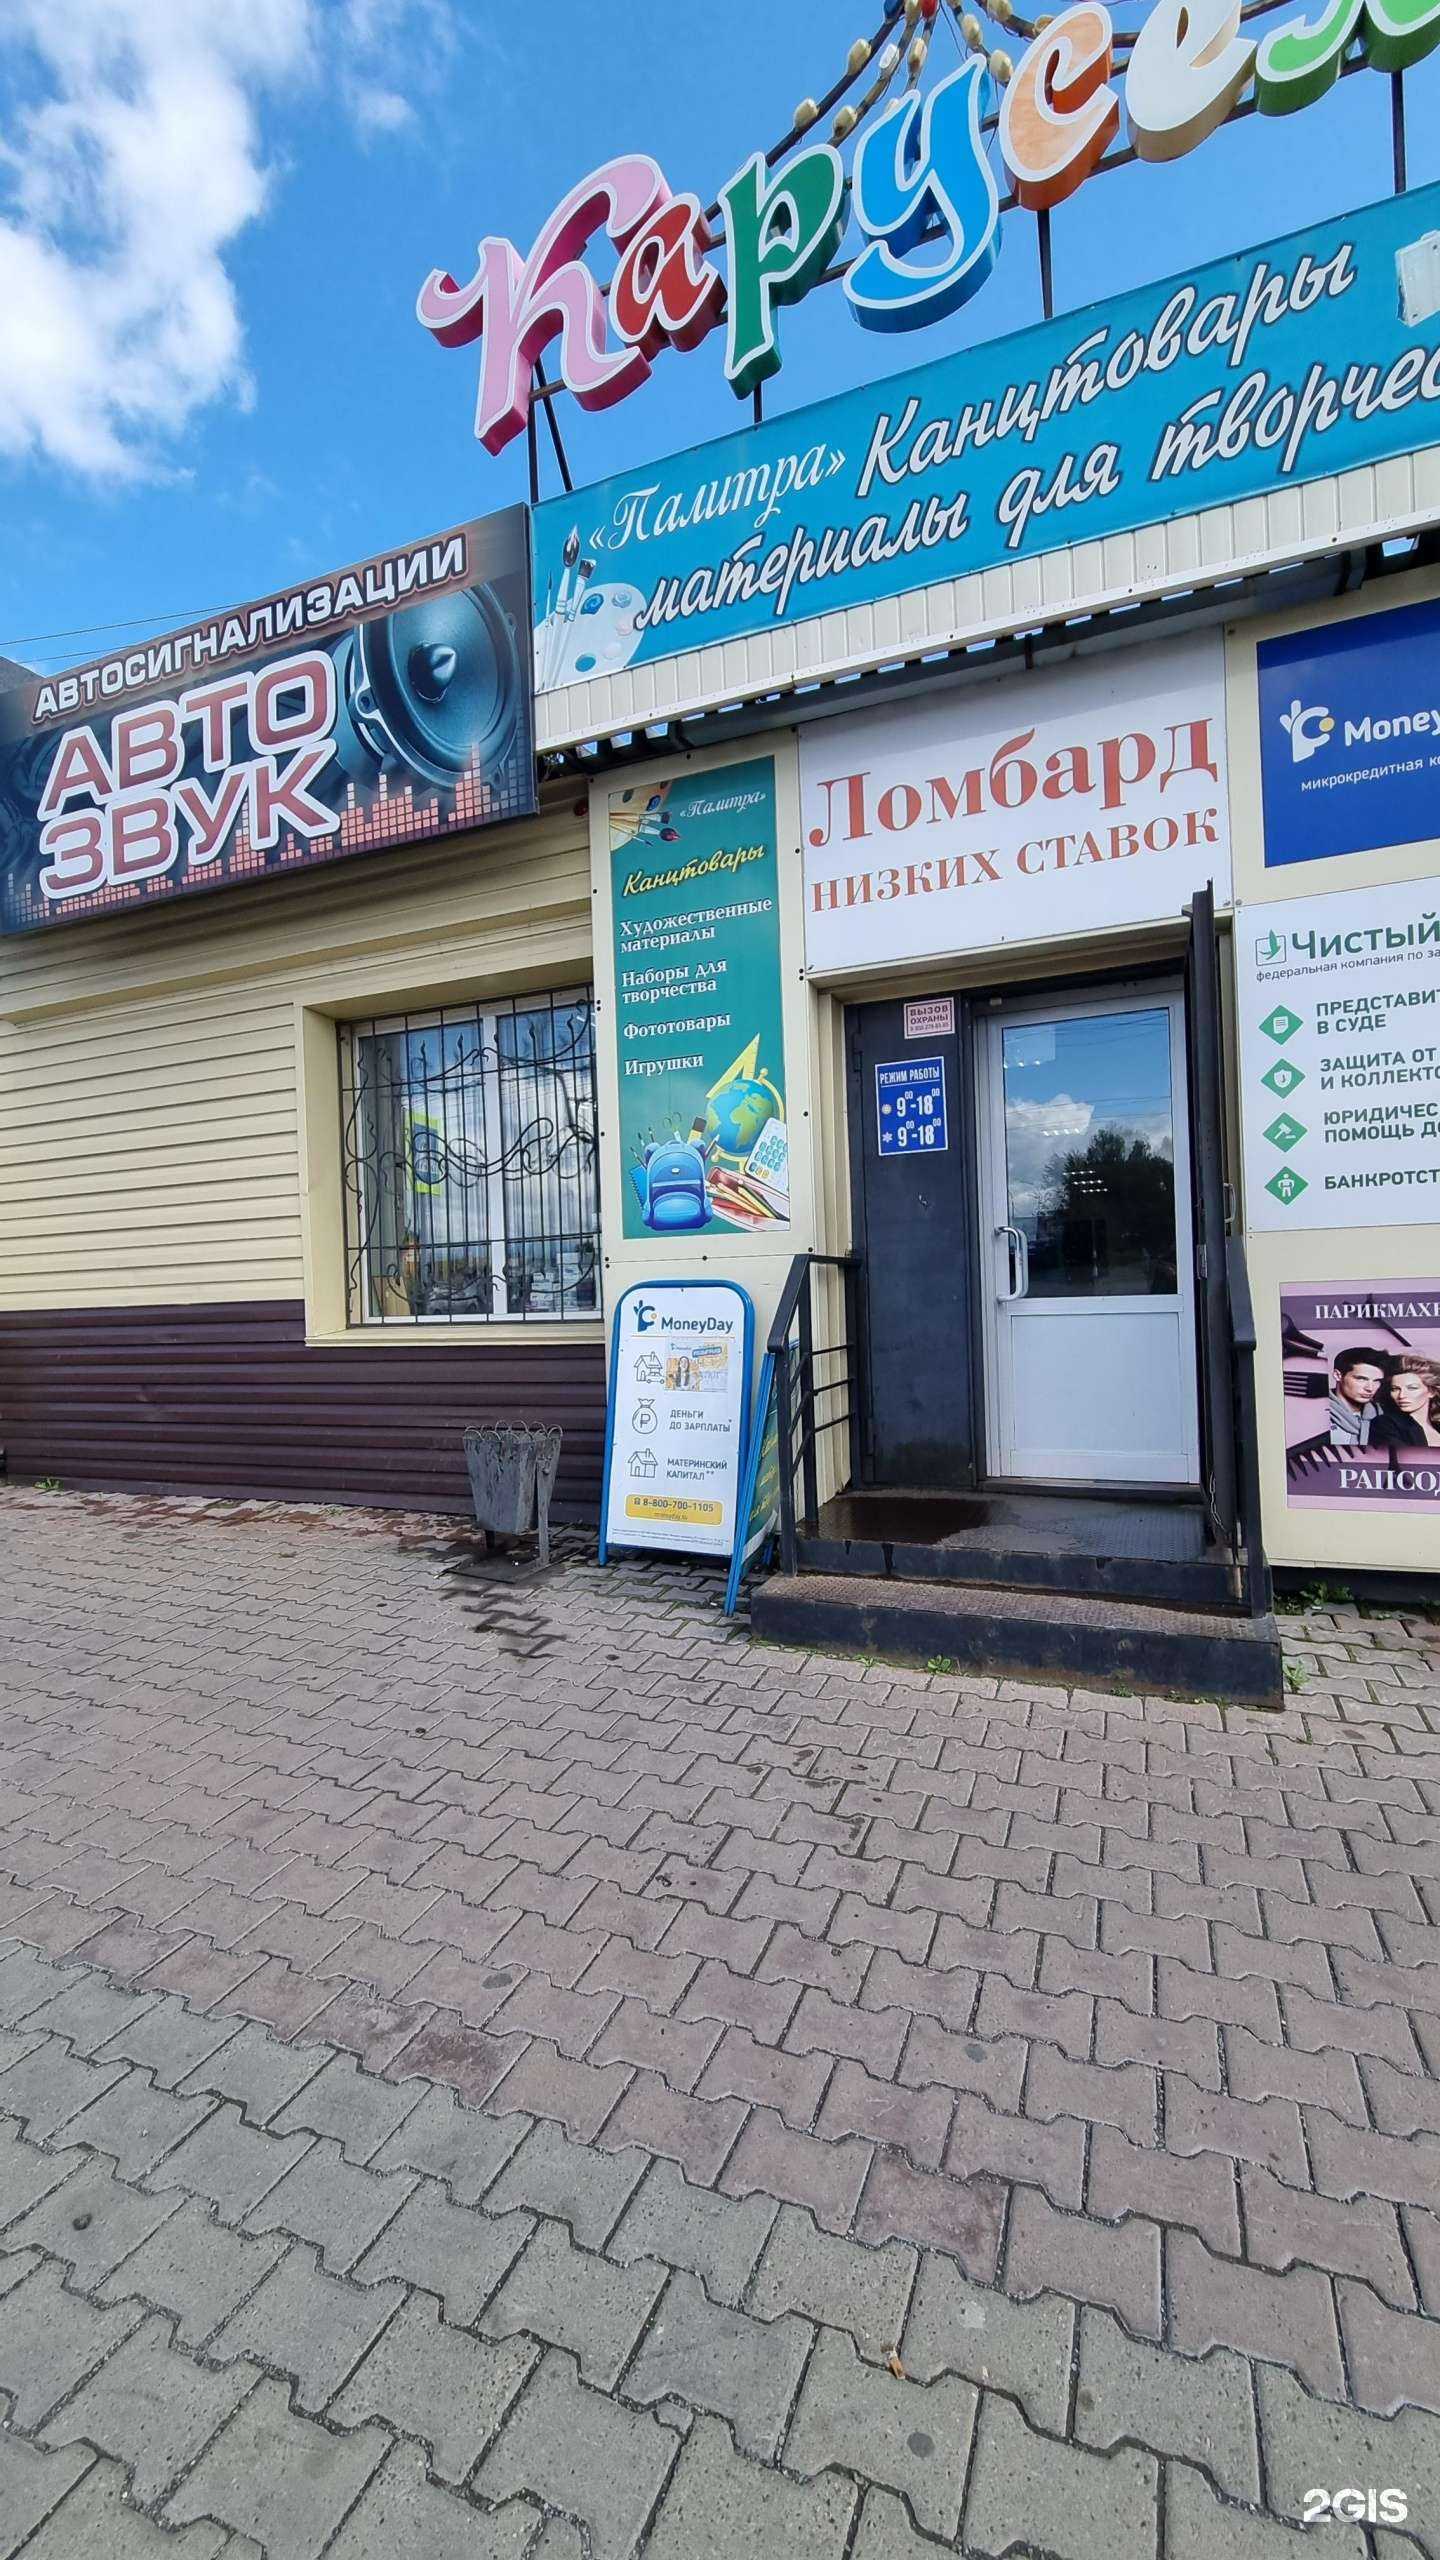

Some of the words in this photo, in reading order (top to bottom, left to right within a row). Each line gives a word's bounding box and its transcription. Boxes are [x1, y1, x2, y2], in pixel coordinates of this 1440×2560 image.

[857, 244, 1356, 497] Канцтовары
[633, 494, 969, 630] материалы
[998, 443, 1121, 549] для
[34, 535, 465, 719] АВТОСИГНАЛИЗАЦИИ
[38, 650, 337, 821] АВТО
[808, 717, 1219, 847] Ломбард
[1301, 757, 1424, 793] микрокредитная
[39, 738, 340, 900] ЗВУК
[622, 842, 765, 897] Канцтовары
[811, 848, 1003, 912] НИЗКИХ
[1016, 807, 1220, 875] СТАВОК
[619, 897, 772, 937] Художественные
[621, 927, 715, 953] материалы
[1291, 912, 1440, 960] Чистый
[621, 964, 689, 987] Наборы
[695, 958, 727, 980] для
[1256, 962, 1338, 982] федеральная
[1340, 953, 1404, 971] компания
[1407, 949, 1424, 961] по
[622, 979, 717, 1004] творчества
[910, 1004, 948, 1016] ВЫЗОВ
[910, 1014, 948, 1025] ОХРАНЫ
[623, 1013, 731, 1040] Фототовары
[1317, 1021, 1330, 1035] В
[1335, 1014, 1387, 1034] СУДЕ
[624, 1055, 704, 1077] Игрушки
[1320, 1050, 1406, 1073] ЗАЩИТА
[1411, 1047, 1437, 1064] ОТ
[880, 1070, 907, 1084] РЕЖИМ
[910, 1066, 940, 1081] РАБОТЫ
[1321, 1075, 1334, 1091] И
[1324, 1102, 1438, 1125] ЮРИДИЧЕС
[1325, 1122, 1415, 1143] ПОМОЩЬ
[1324, 1168, 1440, 1190] БАНКРОТСТ
[661, 1316, 733, 1334] MoneyDay
[669, 1421, 682, 1430] ДО
[670, 1409, 704, 1419] ДЕНЬГИ
[667, 1458, 728, 1470] МАТЕРИНСКИЙ
[643, 1498, 714, 1513] 8-800-700-1105
